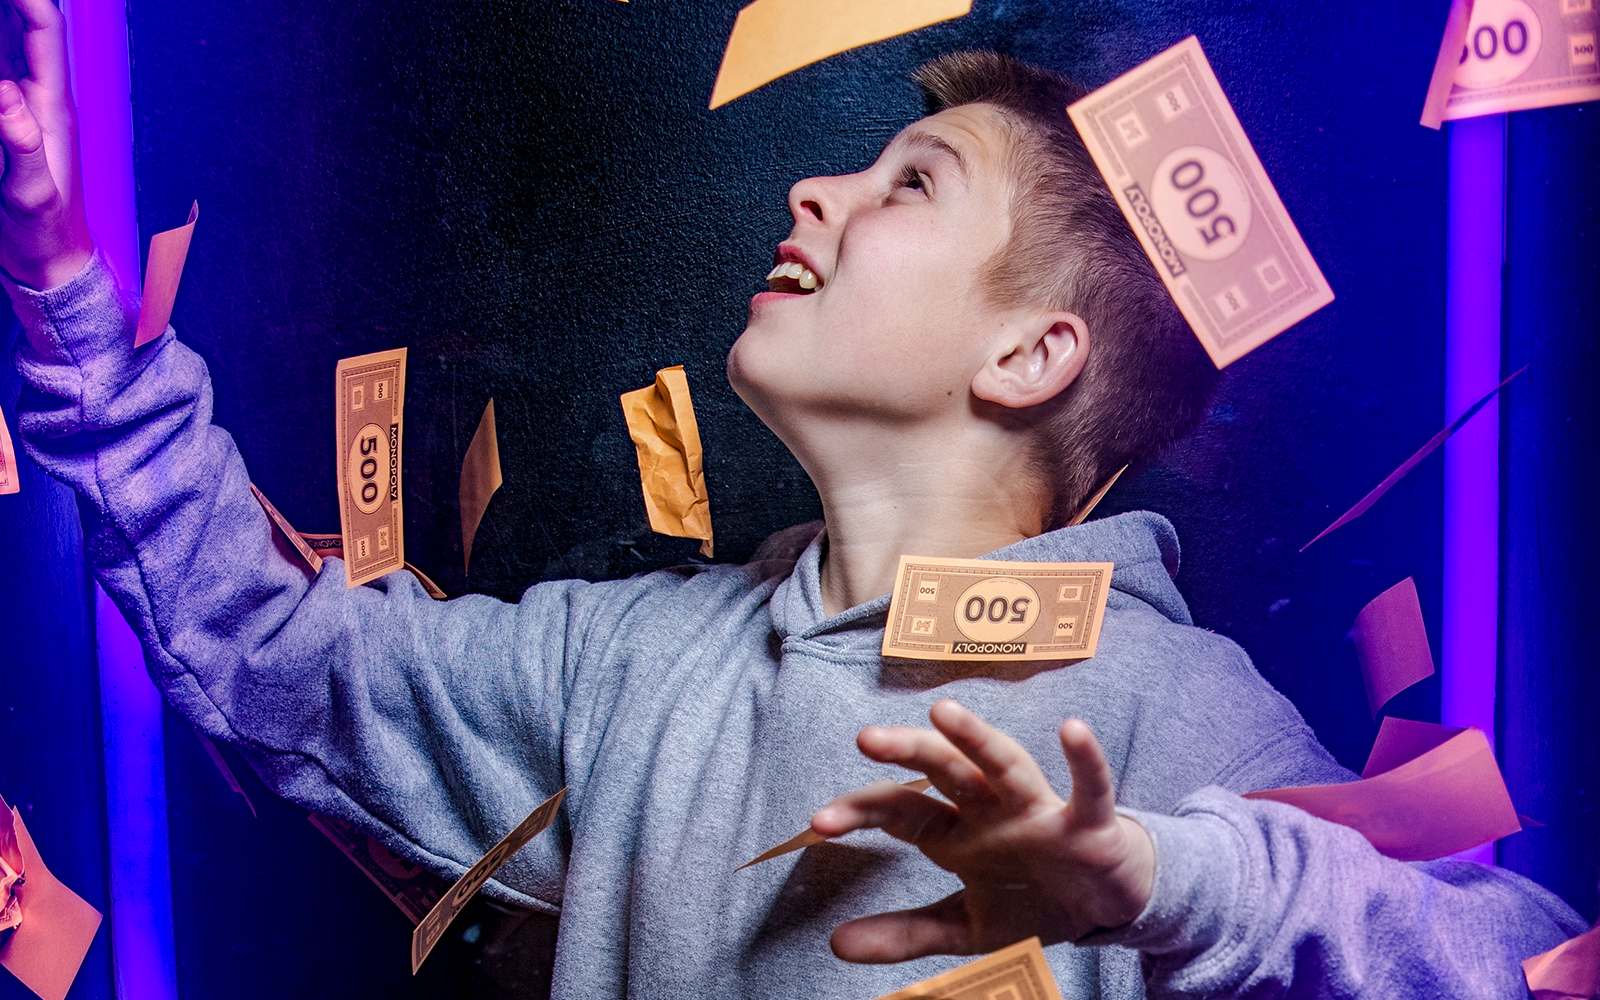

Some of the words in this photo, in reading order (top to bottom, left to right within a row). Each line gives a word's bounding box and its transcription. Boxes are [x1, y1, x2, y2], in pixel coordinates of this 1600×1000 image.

[1459, 20, 1528, 64] 00
[1170, 160, 1235, 245] 500
[1125, 185, 1185, 276] MONOPOLY
[360, 435, 378, 503] 500
[390, 427, 398, 499] MONOPOLY
[307, 540, 343, 548] ONOPO
[919, 587, 936, 595] 500
[964, 596, 1032, 624] 500
[1058, 622, 1073, 630] 500
[954, 642, 1025, 654] MONOPOLY
